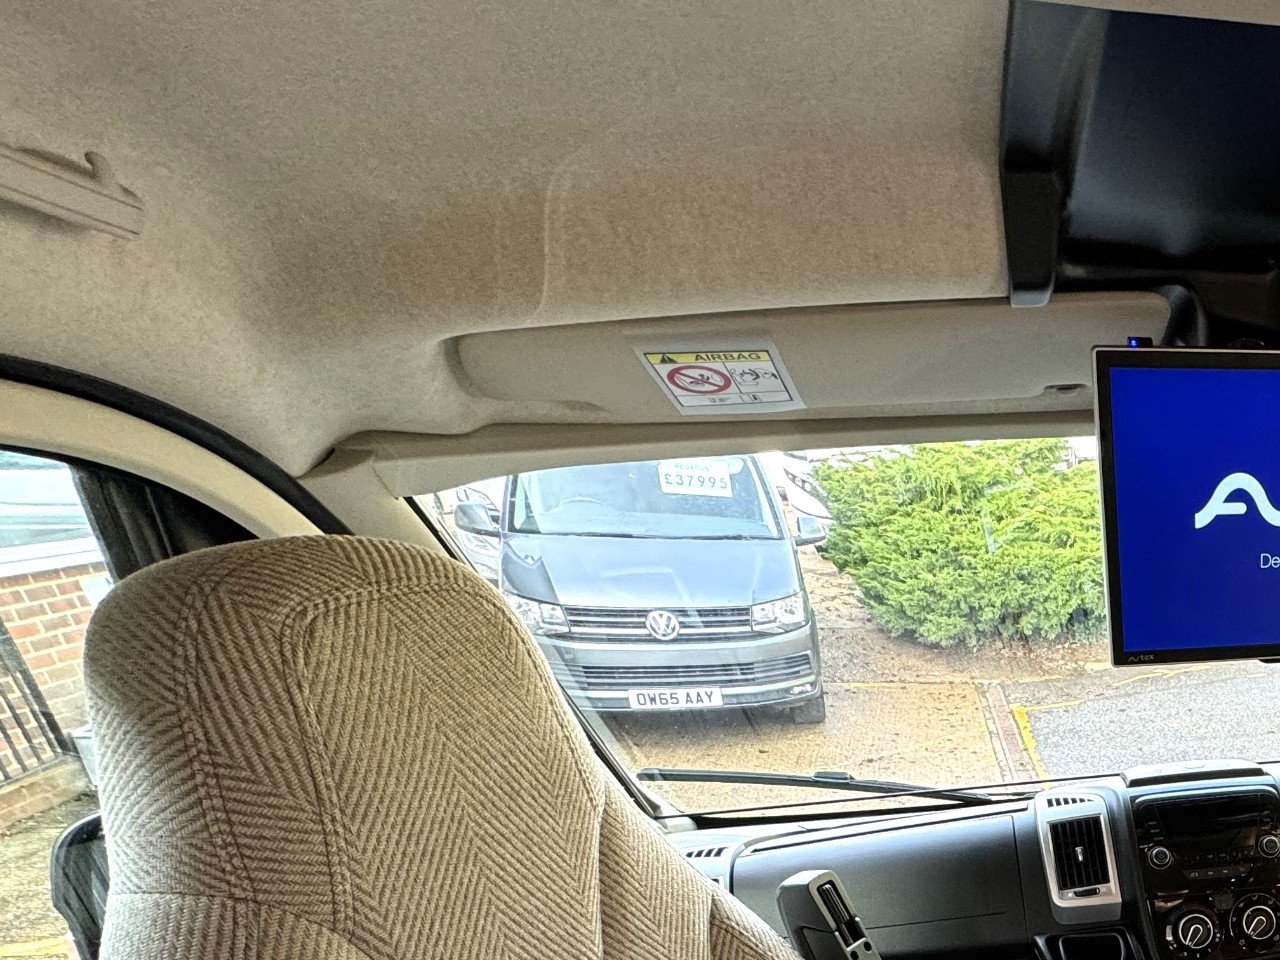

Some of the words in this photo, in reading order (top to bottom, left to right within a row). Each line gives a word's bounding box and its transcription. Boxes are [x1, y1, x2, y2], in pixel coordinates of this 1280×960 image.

[694, 352, 762, 362] AIRBAG
[664, 473, 728, 489] £37995
[685, 690, 714, 704] AAY
